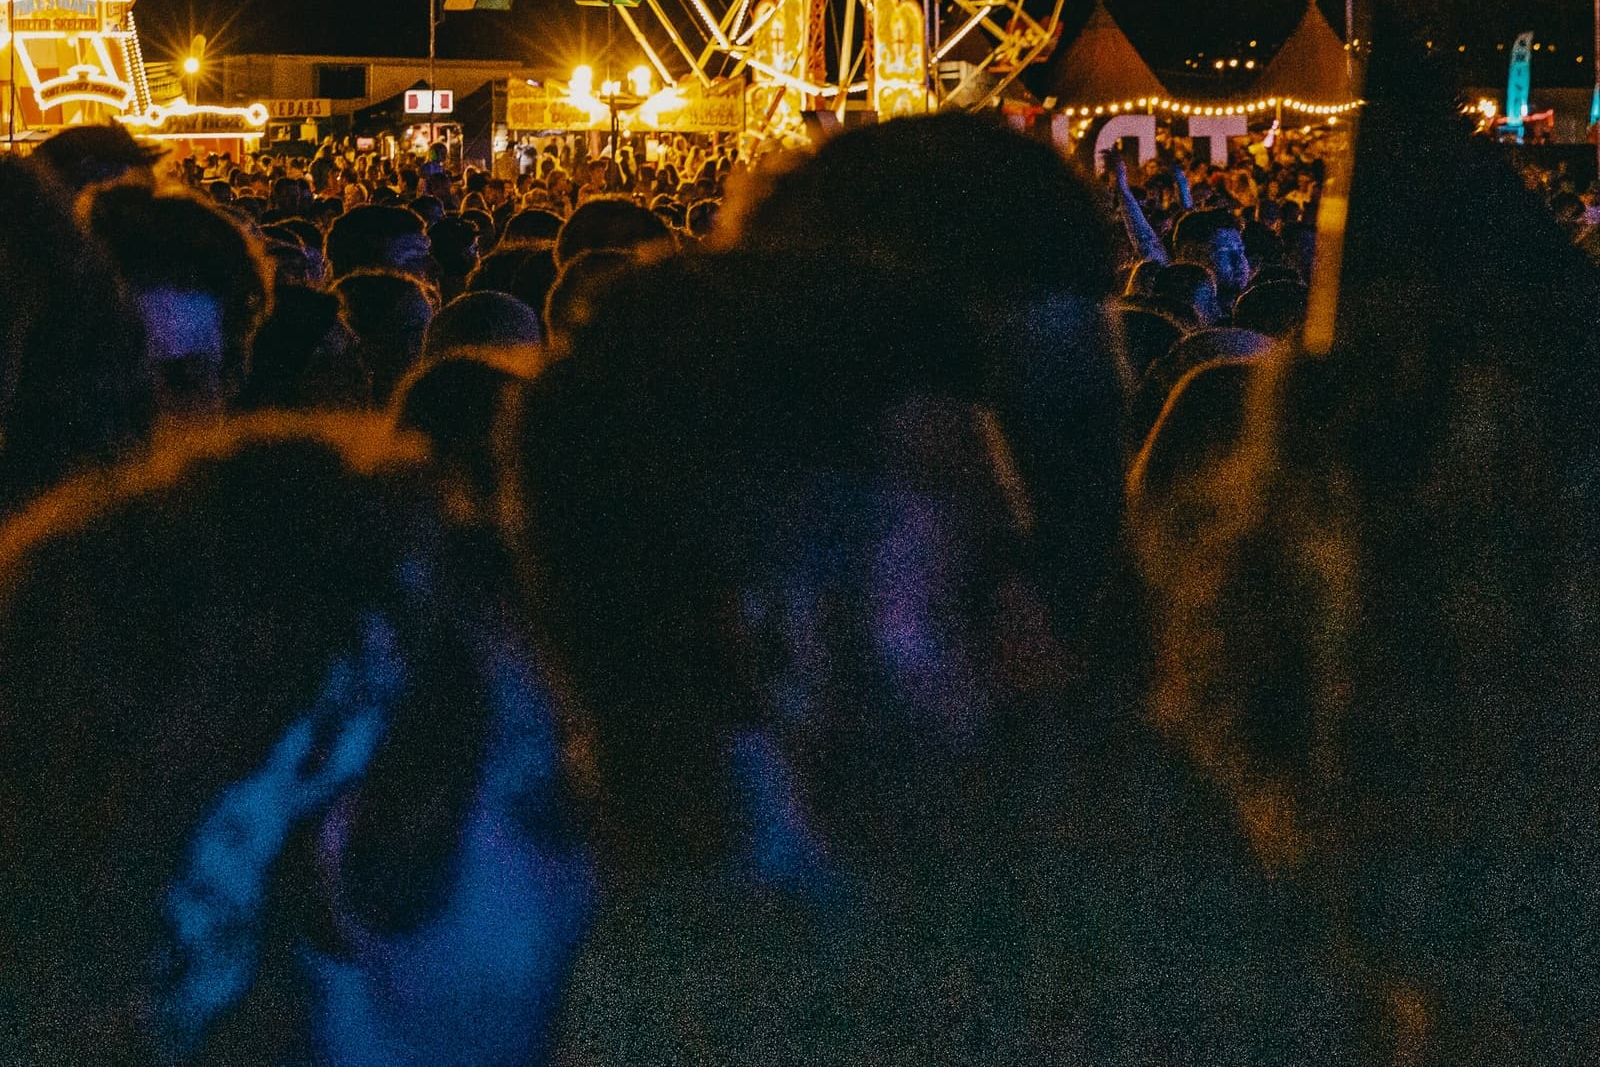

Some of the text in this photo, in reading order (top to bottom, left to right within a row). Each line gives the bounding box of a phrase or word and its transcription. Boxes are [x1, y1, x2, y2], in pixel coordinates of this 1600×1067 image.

[14, 18, 97, 31] HELTER SKELTER
[269, 99, 322, 116] KEBABS
